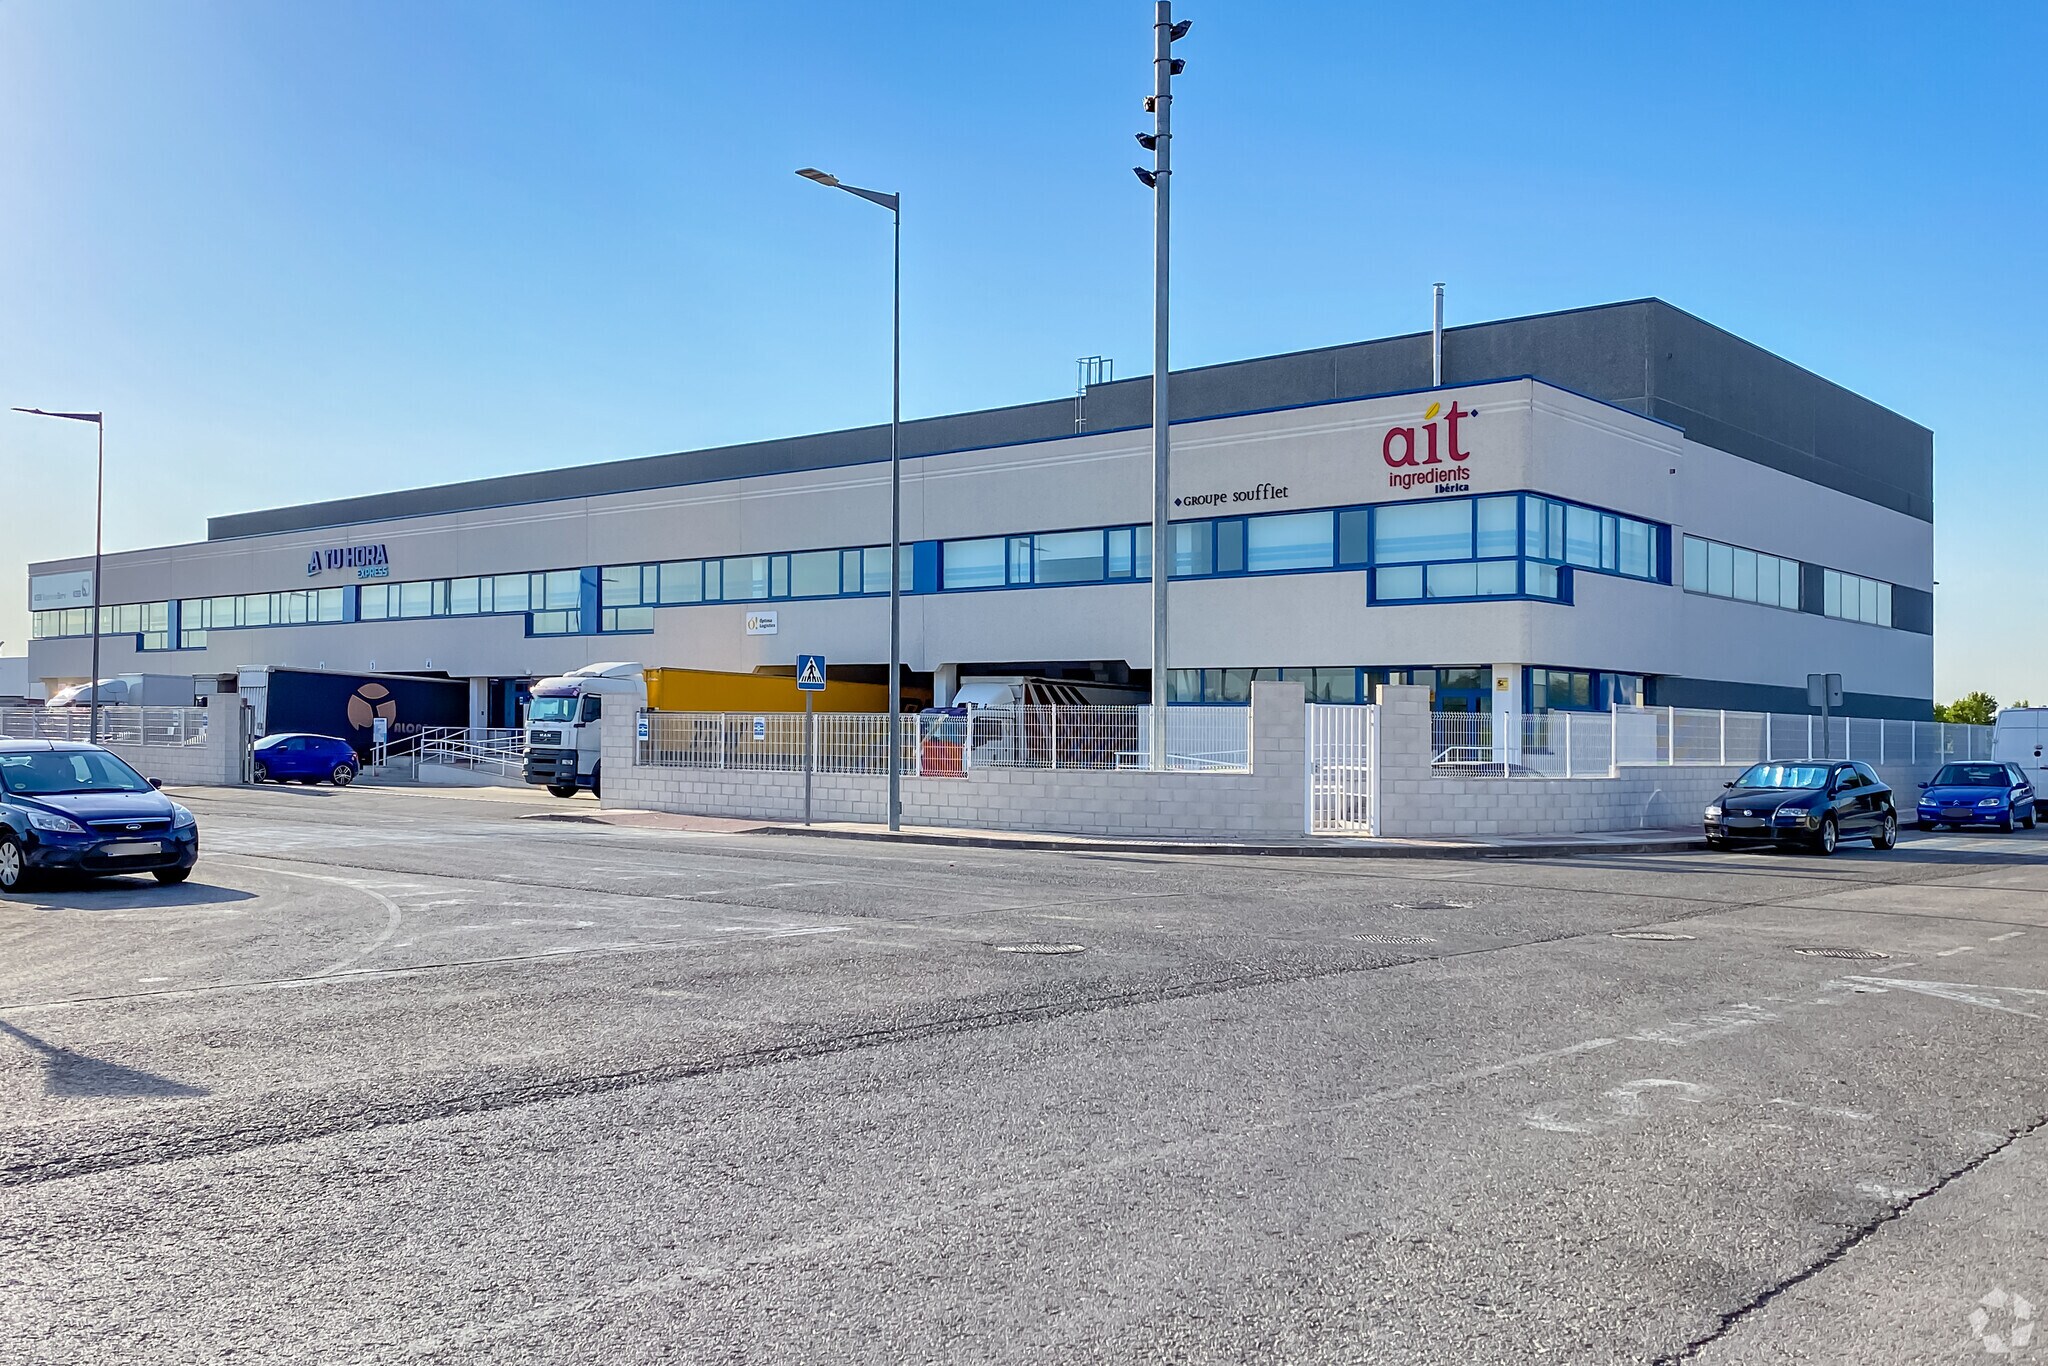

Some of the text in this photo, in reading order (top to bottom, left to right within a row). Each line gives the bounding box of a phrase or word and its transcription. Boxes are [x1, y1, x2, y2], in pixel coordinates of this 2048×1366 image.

[1383, 401, 1470, 467] ait
[1389, 465, 1470, 489] ingredients
[308, 544, 389, 575] A TU HORA
[358, 567, 389, 579] EXPRESS
